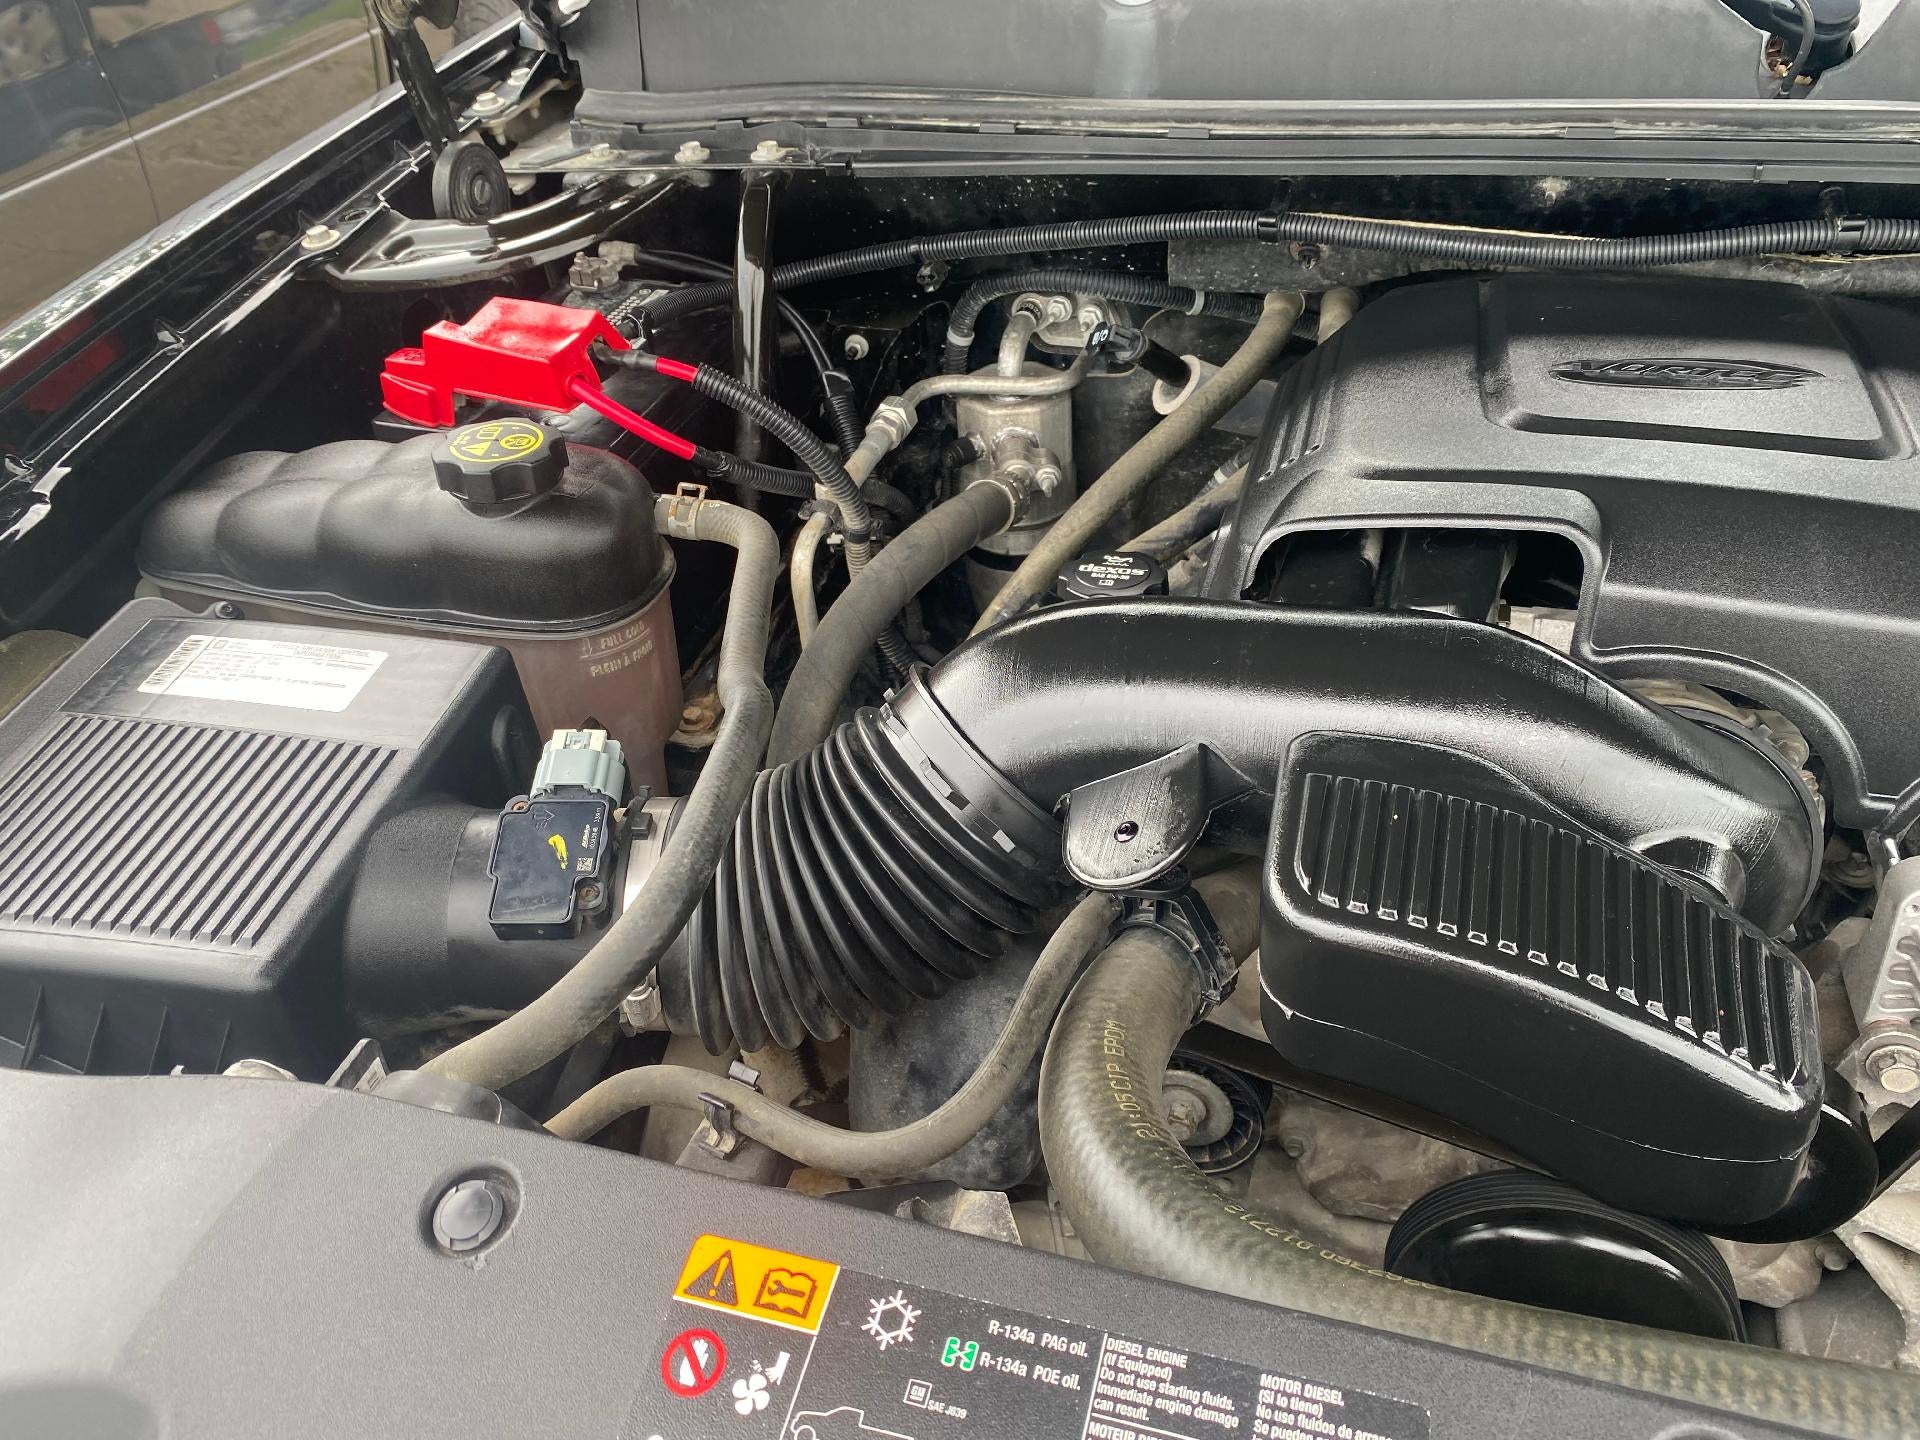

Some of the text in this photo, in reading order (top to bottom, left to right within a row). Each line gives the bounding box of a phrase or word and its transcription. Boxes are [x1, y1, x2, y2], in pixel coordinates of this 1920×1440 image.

[1079, 564, 1148, 575] dexos
[1103, 1019, 1128, 1057] EPDM
[988, 1319, 1089, 1358] R-134a PAG oil.
[1106, 1338, 1188, 1368] DIESEL ENGINE
[979, 1352, 1081, 1391] R-134a POE oil.
[1117, 1356, 1173, 1381] Equipped)
[1100, 1366, 1236, 1411] Do not use starting fluids.
[1260, 1373, 1345, 1406] MOTOR DIESEL
[927, 1399, 946, 1413] SAE
[1093, 1398, 1150, 1421] can result.
[1096, 1381, 1239, 1428] Immediate engine damage
[1276, 1393, 1288, 1407] lo
[1289, 1397, 1324, 1418] tiene)
[1253, 1419, 1270, 1435] Se
[1255, 1403, 1272, 1420] No
[1273, 1410, 1295, 1425] use
[1297, 1413, 1336, 1436] fluidos
[1337, 1424, 1353, 1440] de
